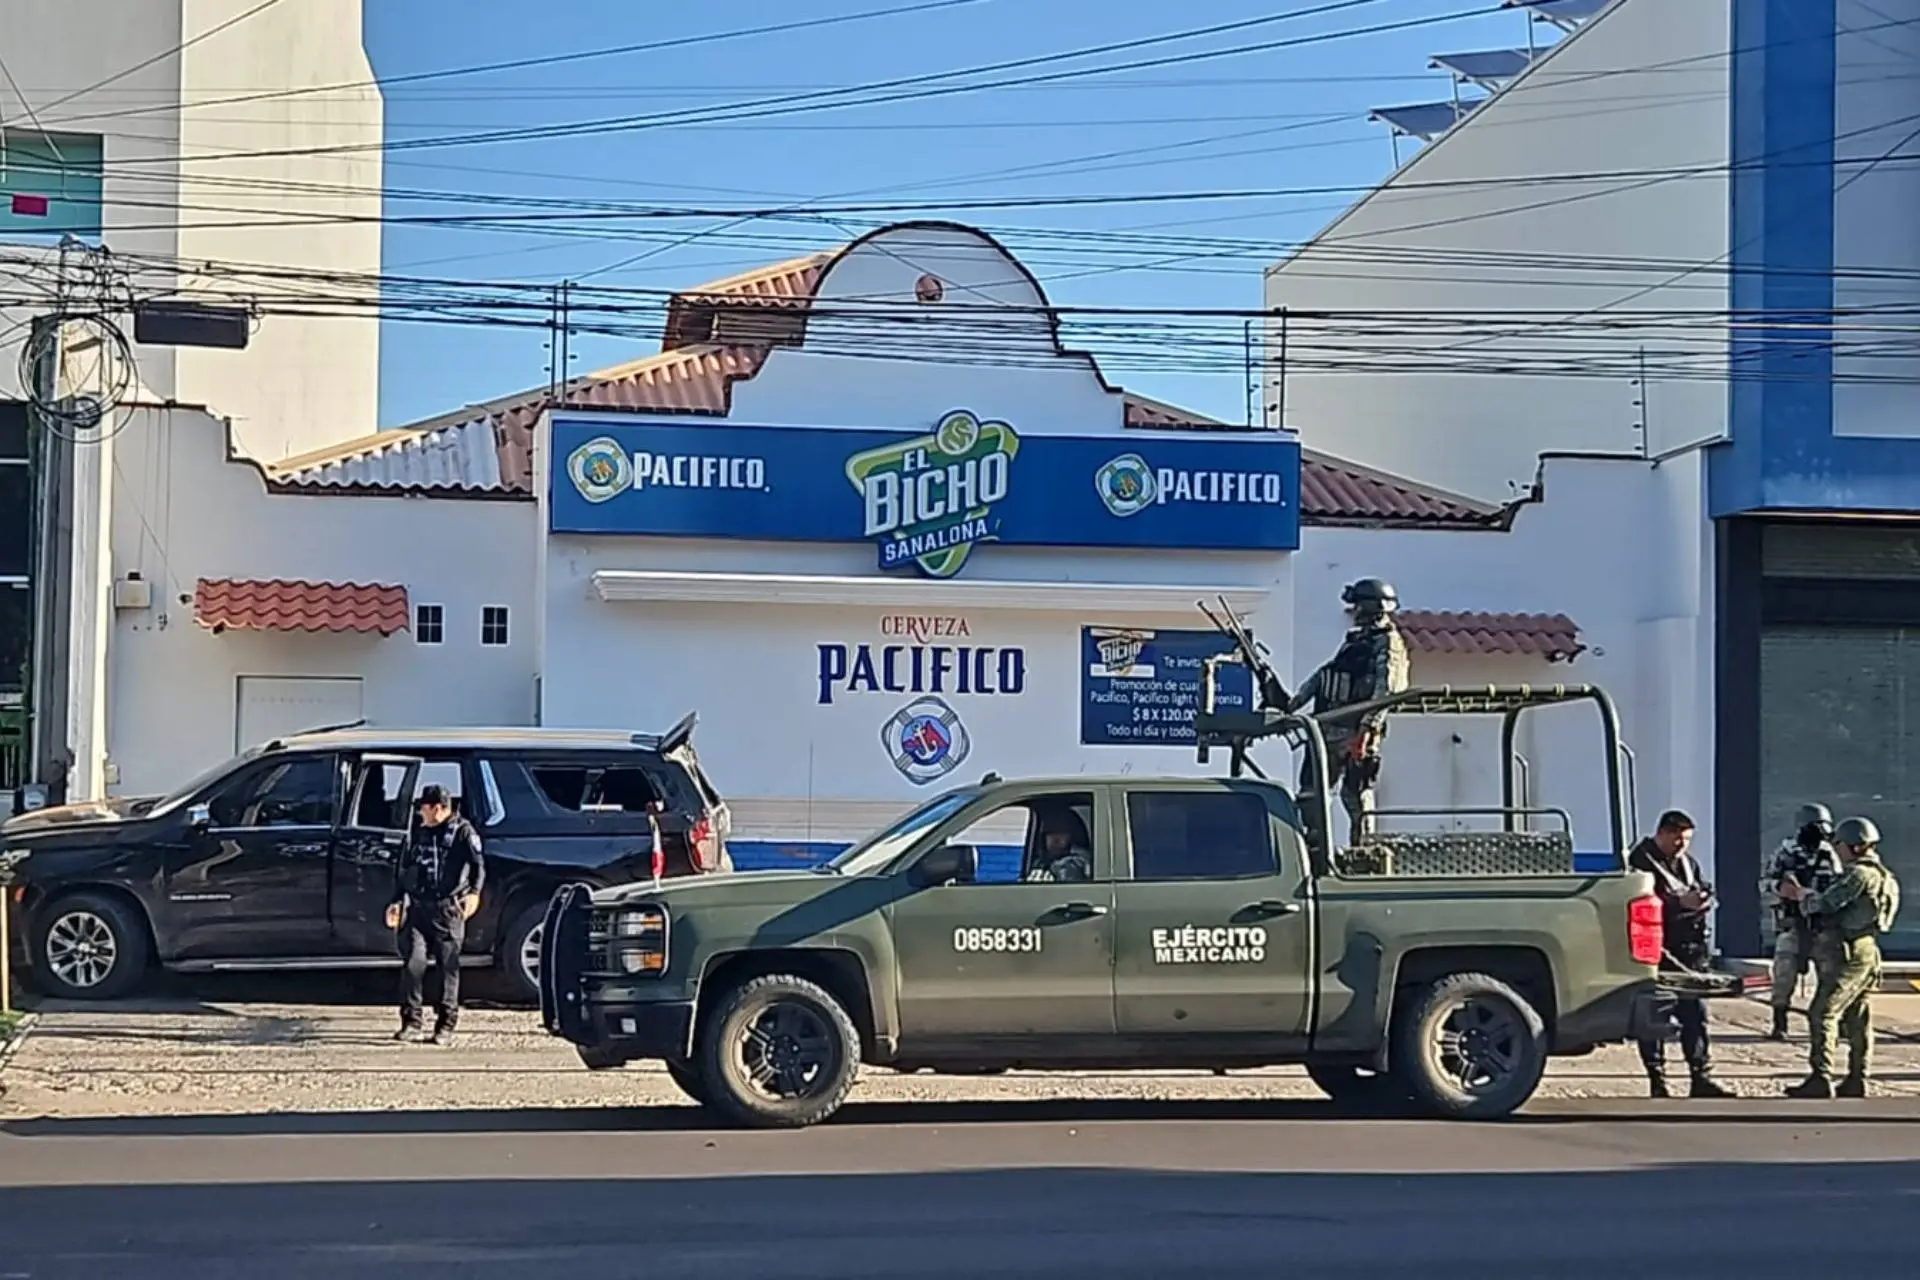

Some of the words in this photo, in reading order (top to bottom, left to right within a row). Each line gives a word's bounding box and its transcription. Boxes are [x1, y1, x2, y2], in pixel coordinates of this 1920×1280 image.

[903, 448, 931, 472] EL
[864, 452, 1008, 536] BICHO
[885, 518, 988, 561] SANALONA
[881, 616, 970, 643] CERVEZA
[1164, 656, 1175, 668] Te
[817, 644, 1026, 704] PACIFICO
[1164, 680, 1177, 691] de
[1171, 692, 1193, 706] light
[1132, 707, 1140, 722] $
[1142, 708, 1150, 721] 8
[1151, 708, 1160, 721] X
[1106, 724, 1131, 737] Todo
[1133, 724, 1142, 737] el
[1161, 727, 1168, 739] y
[954, 928, 1042, 951] 0858331
[1153, 924, 1266, 948] EJÉRCITO
[1155, 947, 1265, 963] MEXICANO
